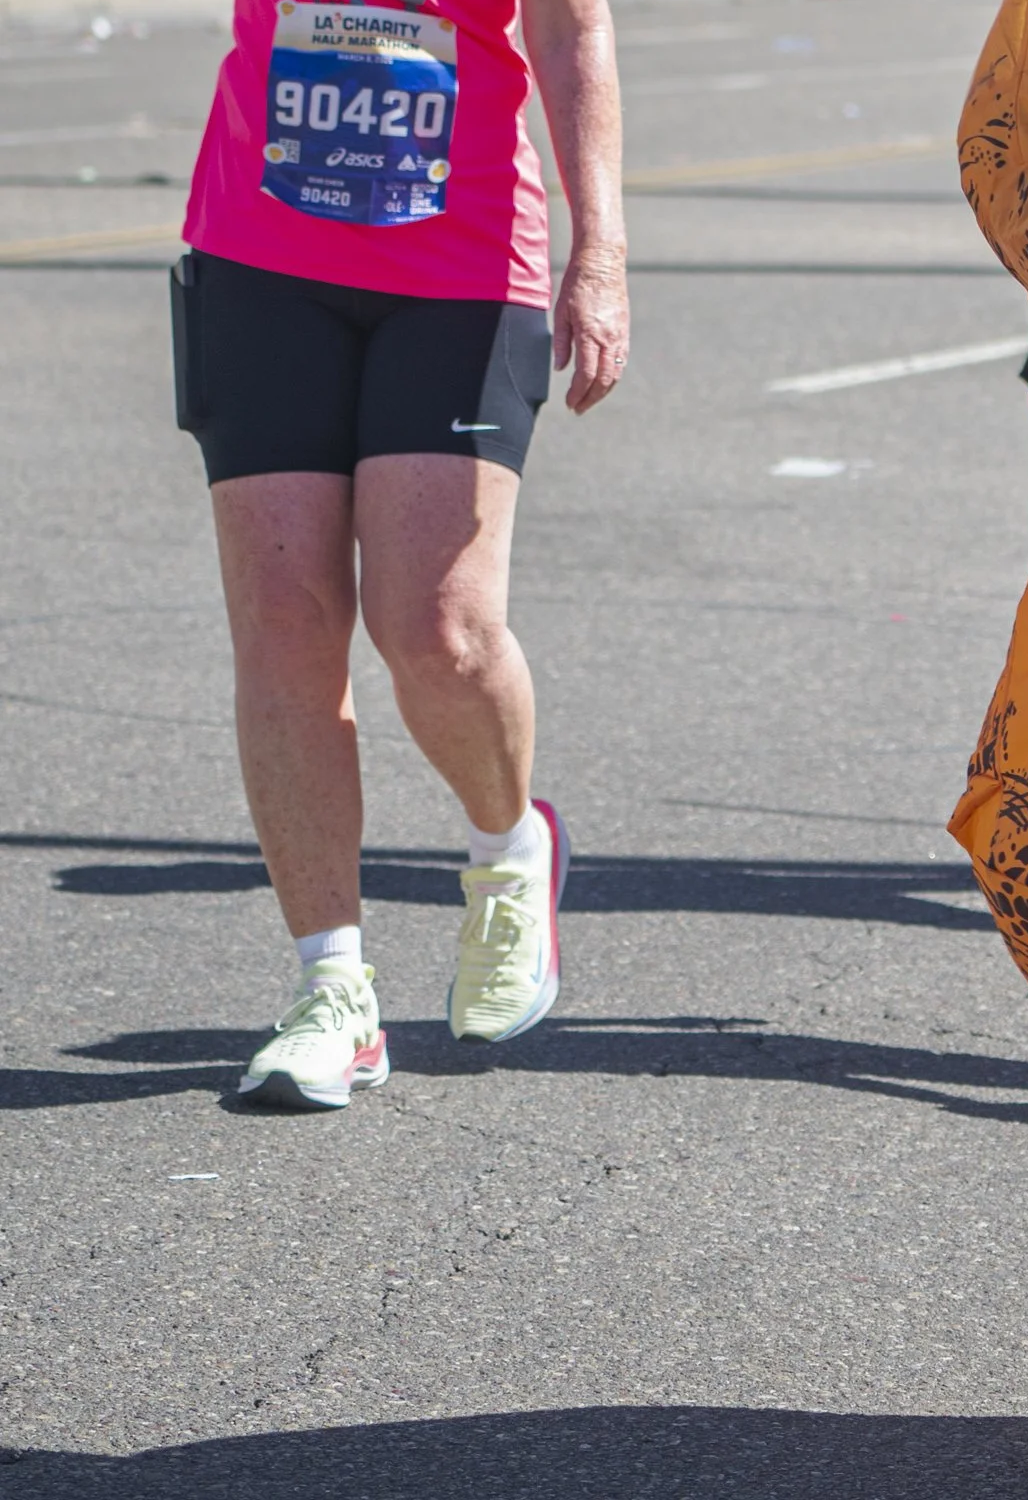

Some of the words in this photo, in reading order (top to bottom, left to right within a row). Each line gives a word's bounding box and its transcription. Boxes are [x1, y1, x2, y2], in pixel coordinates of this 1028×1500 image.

[314, 14, 334, 30] LA
[342, 15, 421, 38] CHARITY
[312, 34, 345, 45] HALF
[347, 35, 421, 50] MARATHON
[275, 81, 446, 138] 90420
[300, 186, 351, 207] 90420
